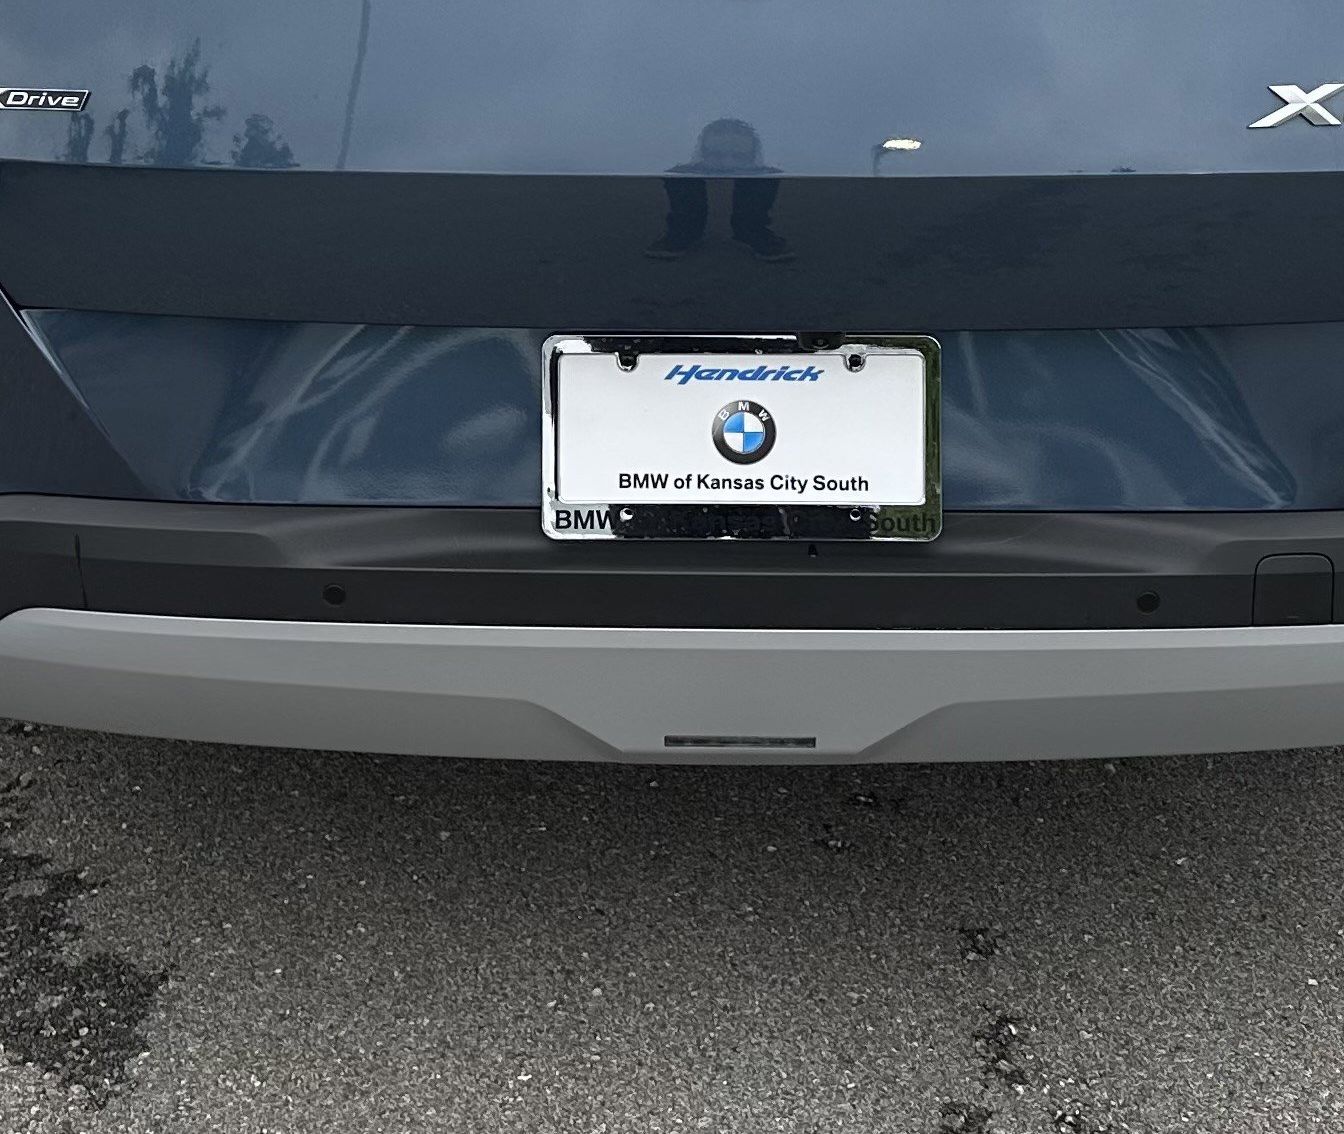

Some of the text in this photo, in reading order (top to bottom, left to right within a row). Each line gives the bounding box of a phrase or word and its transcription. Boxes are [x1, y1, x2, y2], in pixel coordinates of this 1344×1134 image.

[663, 364, 826, 385] Hendrick
[718, 401, 771, 422] BMW
[618, 473, 869, 494] BMW of Kansas City South
[555, 510, 616, 531] BMW
[867, 511, 936, 532] South
